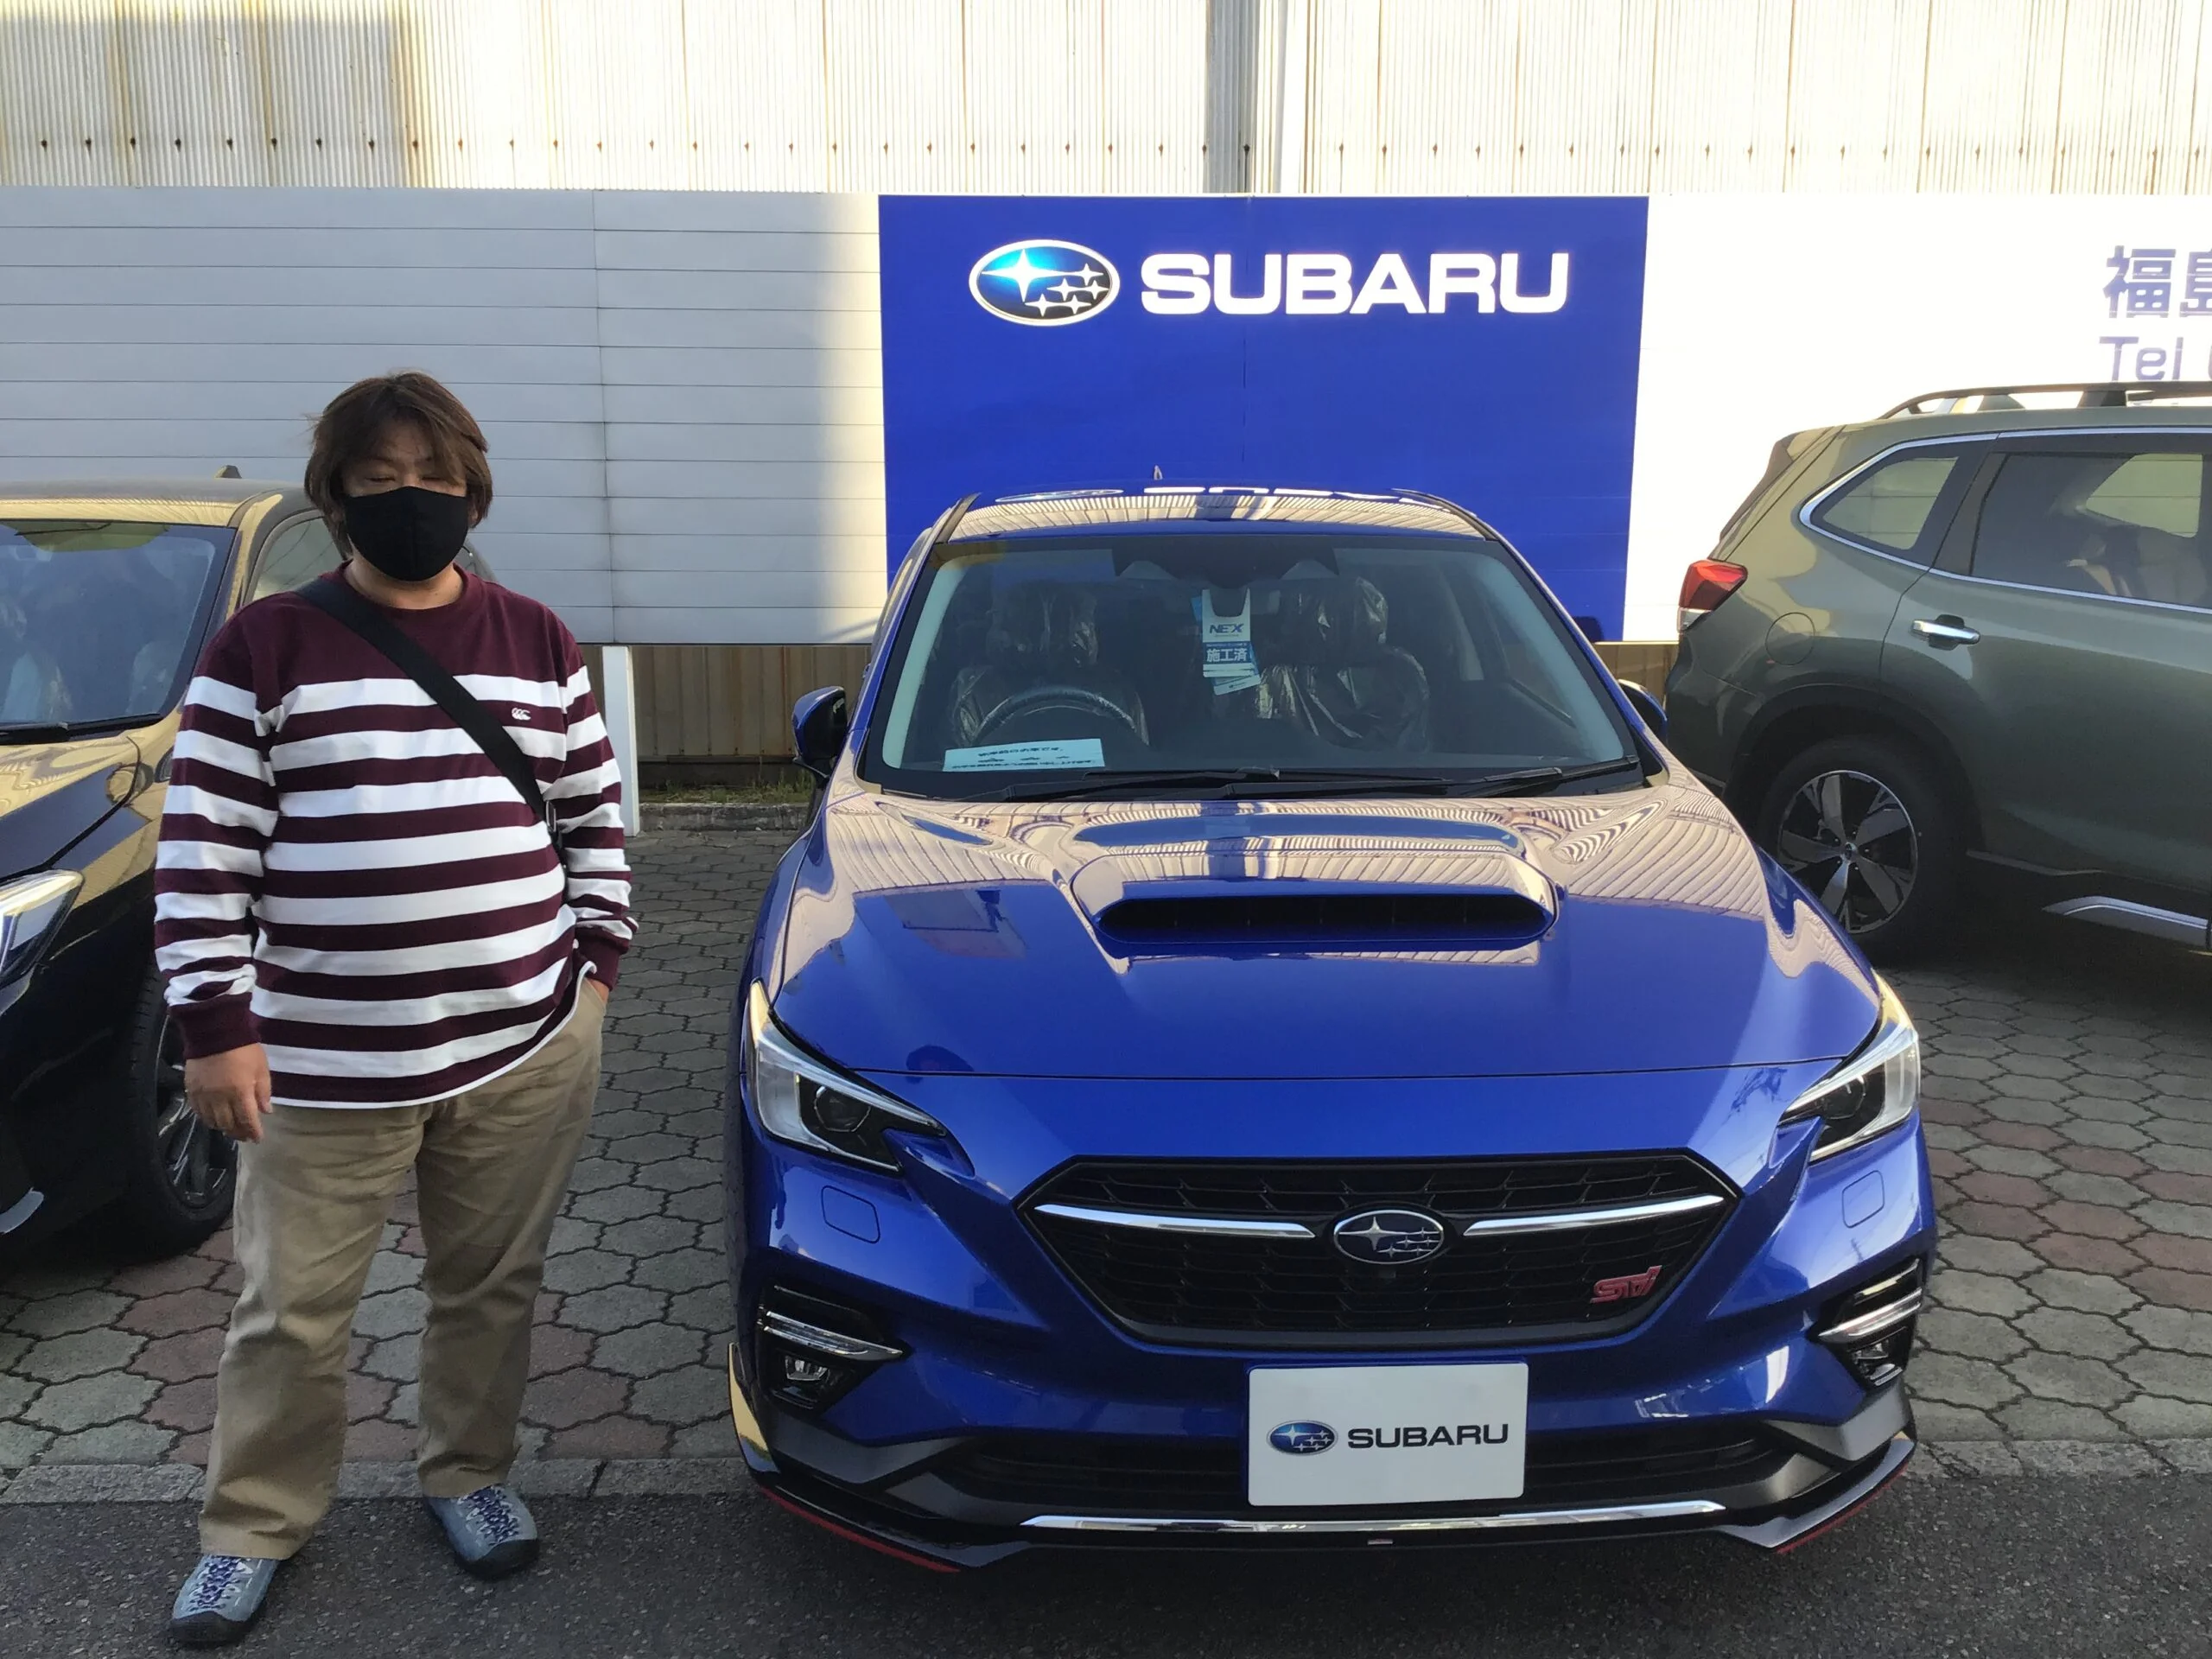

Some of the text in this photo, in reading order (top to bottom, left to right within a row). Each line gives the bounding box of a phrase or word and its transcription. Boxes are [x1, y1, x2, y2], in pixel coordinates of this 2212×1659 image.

[1141, 252, 1569, 315] SUBARU
[2099, 336, 2184, 381] Tel
[1210, 623, 1244, 633] NEX
[1206, 648, 1247, 663] 施工済
[1347, 1423, 1509, 1449] SUBARU
